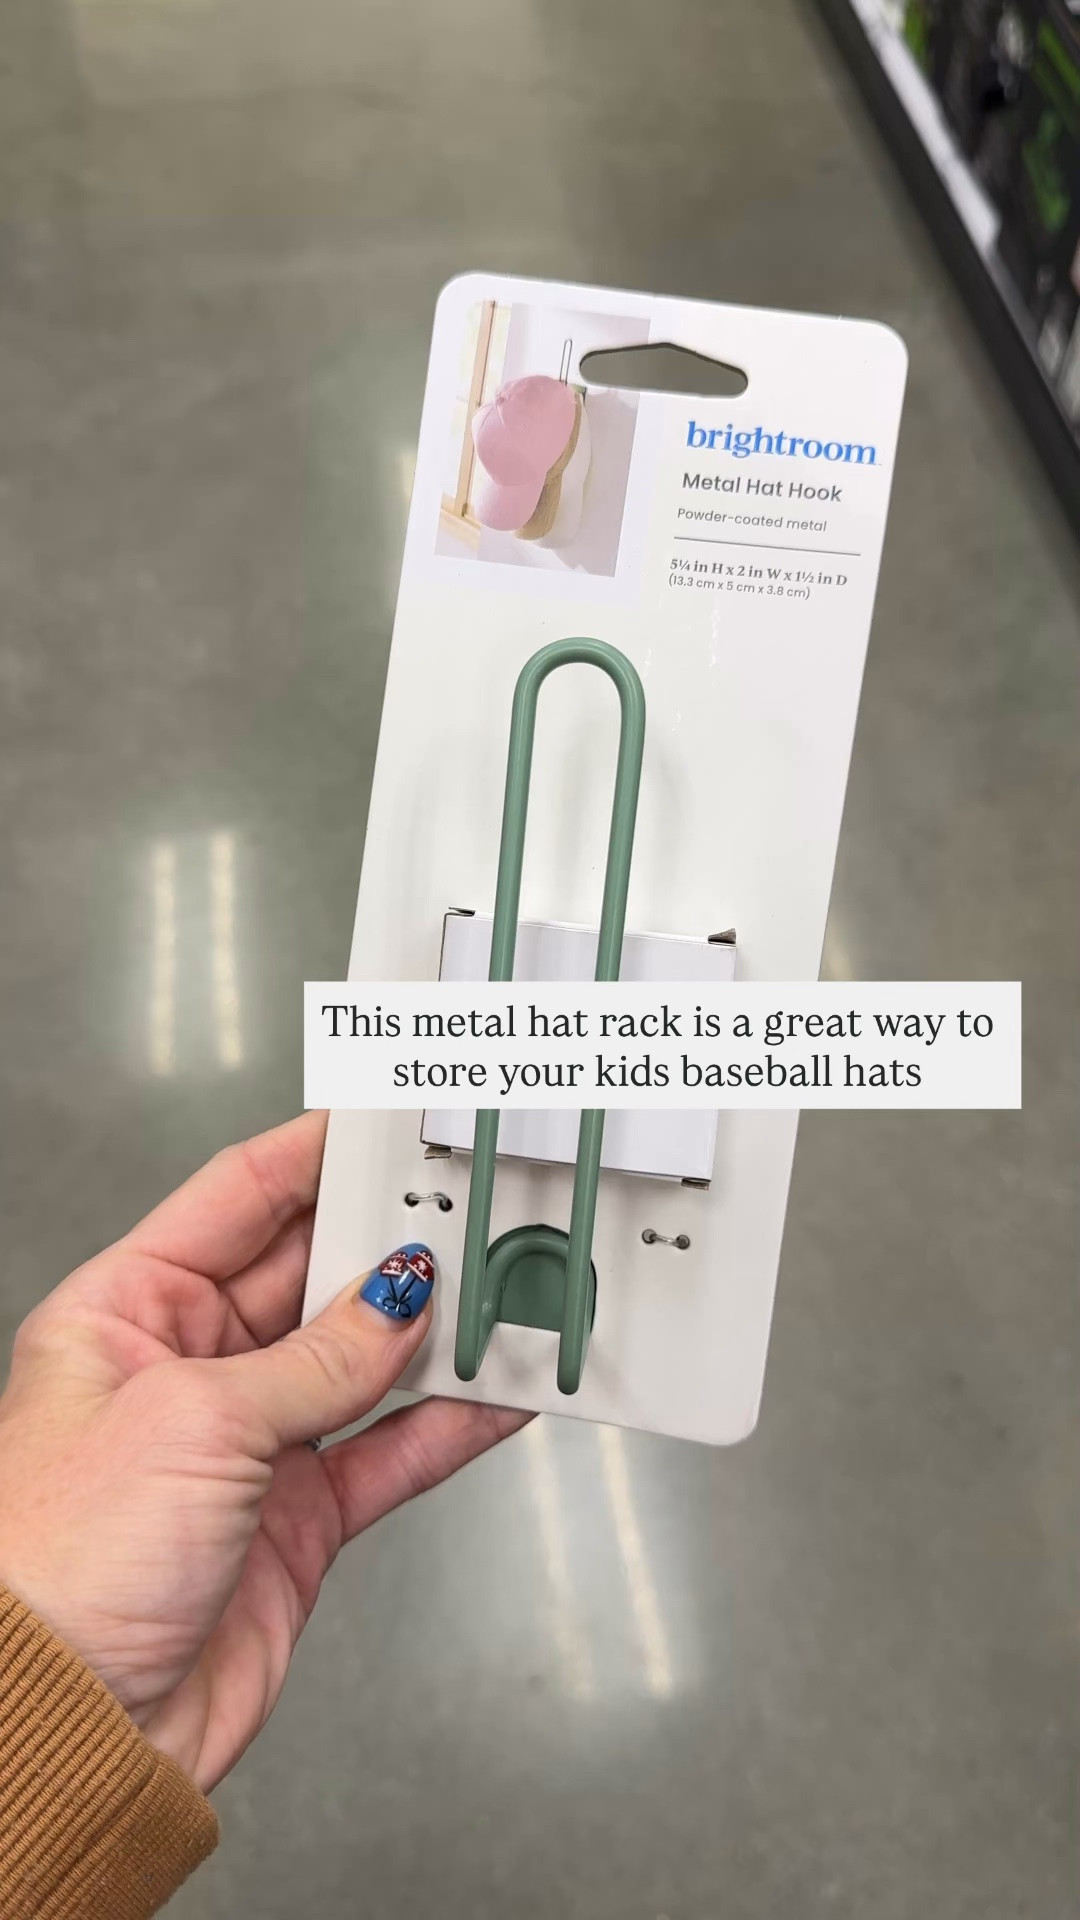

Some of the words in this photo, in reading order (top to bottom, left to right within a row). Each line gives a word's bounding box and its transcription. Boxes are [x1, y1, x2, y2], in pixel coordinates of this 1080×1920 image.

[686, 421, 876, 465] brightroom
[682, 473, 740, 493] Metal
[746, 478, 783, 497] Hat
[788, 482, 843, 502] Hook
[677, 508, 783, 528] Powder-coated
[786, 520, 827, 531] metal
[669, 573, 693, 587] (13.3
[696, 579, 714, 589] cm
[717, 582, 723, 590] x
[726, 582, 733, 591] 5
[736, 584, 754, 593] cm
[758, 586, 763, 594] x
[767, 585, 784, 595] 3.8
[787, 587, 810, 600] cm)
[693, 560, 708, 573] in
[712, 563, 723, 574] H
[725, 566, 734, 575] x
[737, 566, 745, 576] 2
[749, 566, 763, 578] in
[767, 568, 781, 580] W
[784, 571, 792, 581] x
[818, 572, 832, 585] in
[836, 574, 847, 586] D
